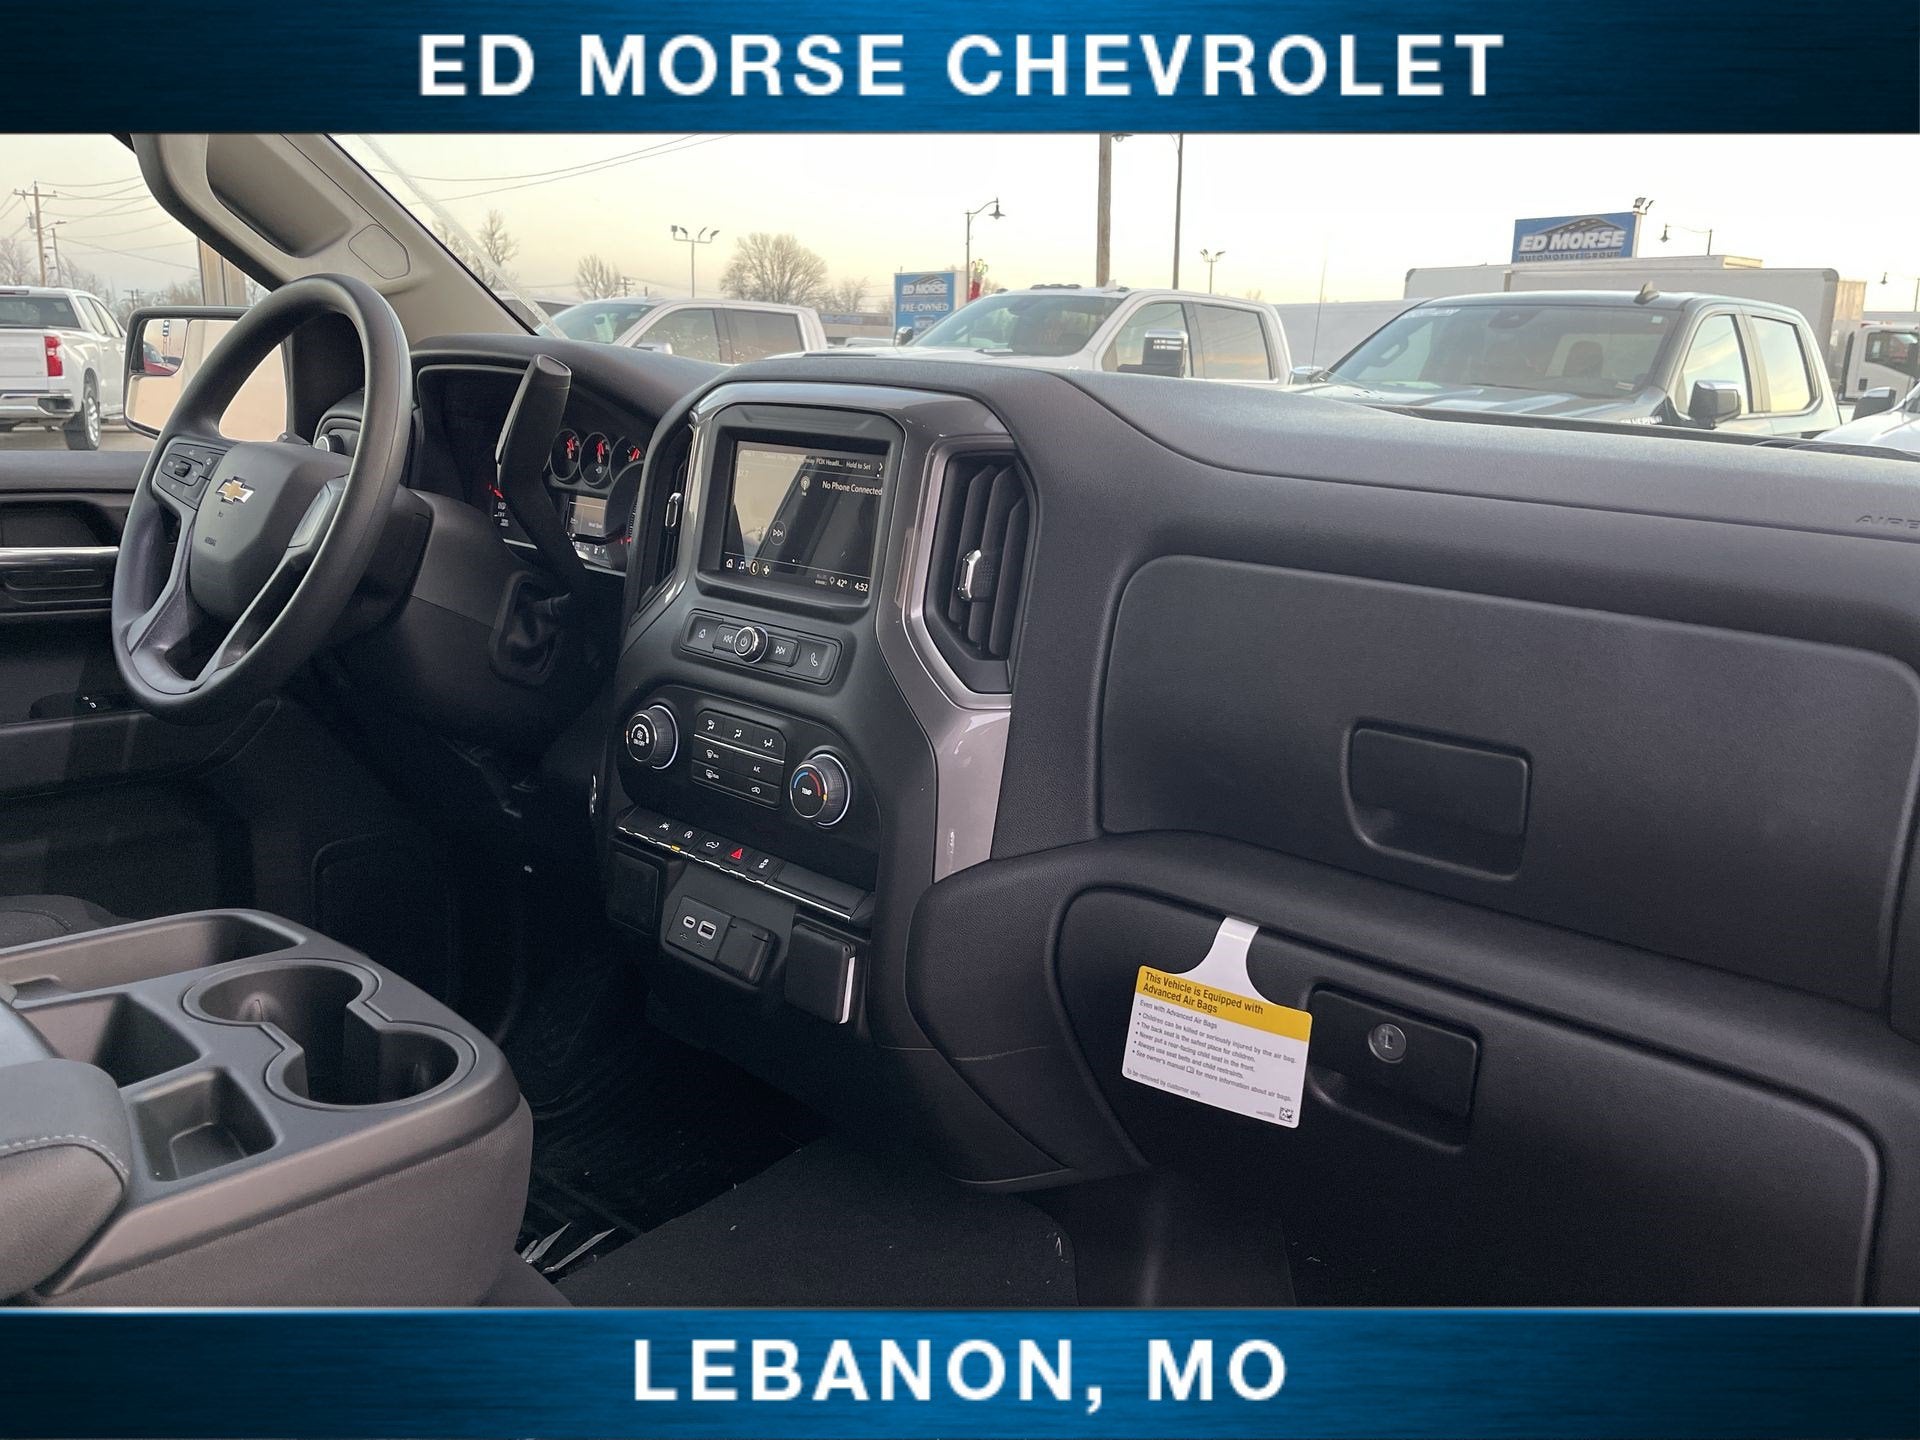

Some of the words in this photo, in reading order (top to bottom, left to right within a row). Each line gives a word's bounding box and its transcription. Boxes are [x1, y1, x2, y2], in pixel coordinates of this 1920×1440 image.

[1519, 234, 1547, 252] ED
[1549, 230, 1627, 250] MORSE
[1519, 252, 1582, 262] AUTOMOTIVE
[1584, 251, 1620, 260] GROUP
[902, 285, 915, 295] ED
[915, 283, 948, 294] MORSE
[901, 303, 949, 312] PRE-OWNED
[846, 461, 857, 469] Hold
[822, 480, 831, 489] No
[832, 482, 850, 492] Phone
[850, 484, 883, 496] Connected
[854, 582, 868, 592] 4:52
[1142, 982, 1181, 1001] Advanced
[1183, 994, 1195, 1006] Air
[1196, 999, 1217, 1014] Bags
[1145, 971, 1162, 984] This
[1162, 977, 1192, 993] Vehicle
[1193, 986, 1200, 996] is
[1203, 989, 1242, 1010] Equipped
[1244, 1001, 1263, 1014] with
[1139, 999, 1152, 1008] Even
[1153, 1004, 1165, 1012] with
[1166, 1008, 1192, 1021] Advanced
[1194, 1016, 1202, 1024] Air
[1203, 1019, 1217, 1029] Bags
[1140, 1021, 1149, 1029] The
[1150, 1025, 1162, 1033] back
[1163, 1029, 1174, 1037] seat
[1181, 1034, 1189, 1042] the
[1190, 1037, 1206, 1047] safest
[1207, 1043, 1221, 1052] place
[1231, 1050, 1255, 1062] children.
[1142, 1012, 1163, 1024] Children
[1183, 1025, 1197, 1035] killed
[1206, 1032, 1231, 1046] seriously
[1232, 1040, 1252, 1052] injured
[1253, 1046, 1260, 1054] by
[1282, 1054, 1296, 1064] bag.
[1137, 1040, 1155, 1051] Always
[1166, 1050, 1177, 1058] seat
[1178, 1054, 1190, 1062] belts
[1202, 1061, 1215, 1070] child
[1216, 1065, 1244, 1079] restraints.
[1139, 1031, 1153, 1040] Never
[1154, 1036, 1162, 1044] put
[1167, 1041, 1196, 1055] rear-facing
[1197, 1049, 1210, 1058] child
[1210, 1054, 1222, 1062] seat
[1230, 1059, 1239, 1067] the
[1240, 1062, 1255, 1072] front.
[1139, 1072, 1159, 1083] removed
[1166, 1081, 1189, 1093] customer
[1146, 1053, 1165, 1064] owner's
[1166, 1060, 1185, 1070] manual
[1204, 1072, 1217, 1080] more
[1218, 1076, 1249, 1090] information
[1250, 1085, 1266, 1095] about
[1276, 1092, 1291, 1102] bags.
